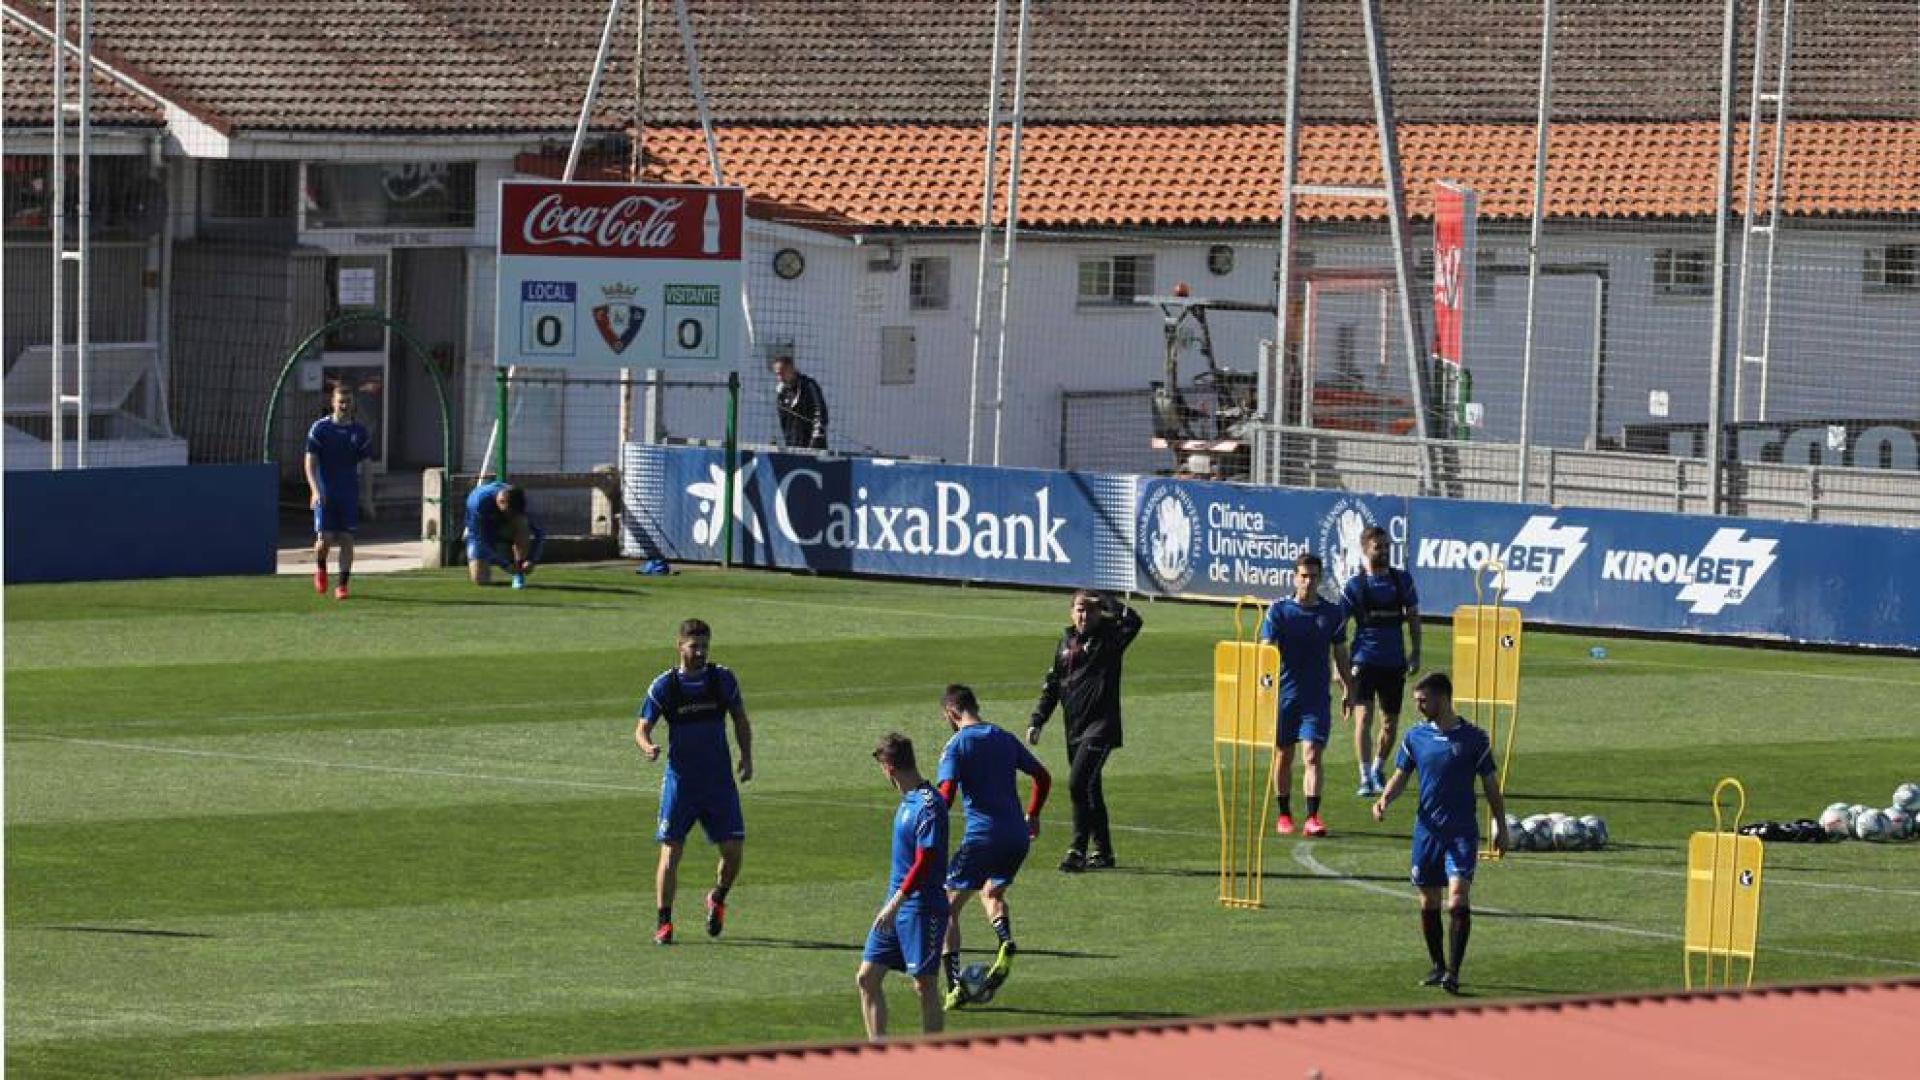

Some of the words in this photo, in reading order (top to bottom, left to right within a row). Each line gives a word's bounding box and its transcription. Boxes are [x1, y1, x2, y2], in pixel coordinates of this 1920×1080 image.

[523, 193, 683, 247] Coca-Cola
[528, 284, 569, 299] LOCAL
[665, 287, 720, 303] VISITANTE
[537, 316, 562, 347] 0
[678, 318, 702, 349] 0
[775, 469, 1070, 563] CaixaBank
[1208, 529, 1310, 560] Universidad
[1417, 539, 1566, 574] KIROLBET
[1209, 557, 1230, 582] de
[1235, 559, 1294, 586] Navarr
[1602, 550, 1754, 586] KIROLBET
